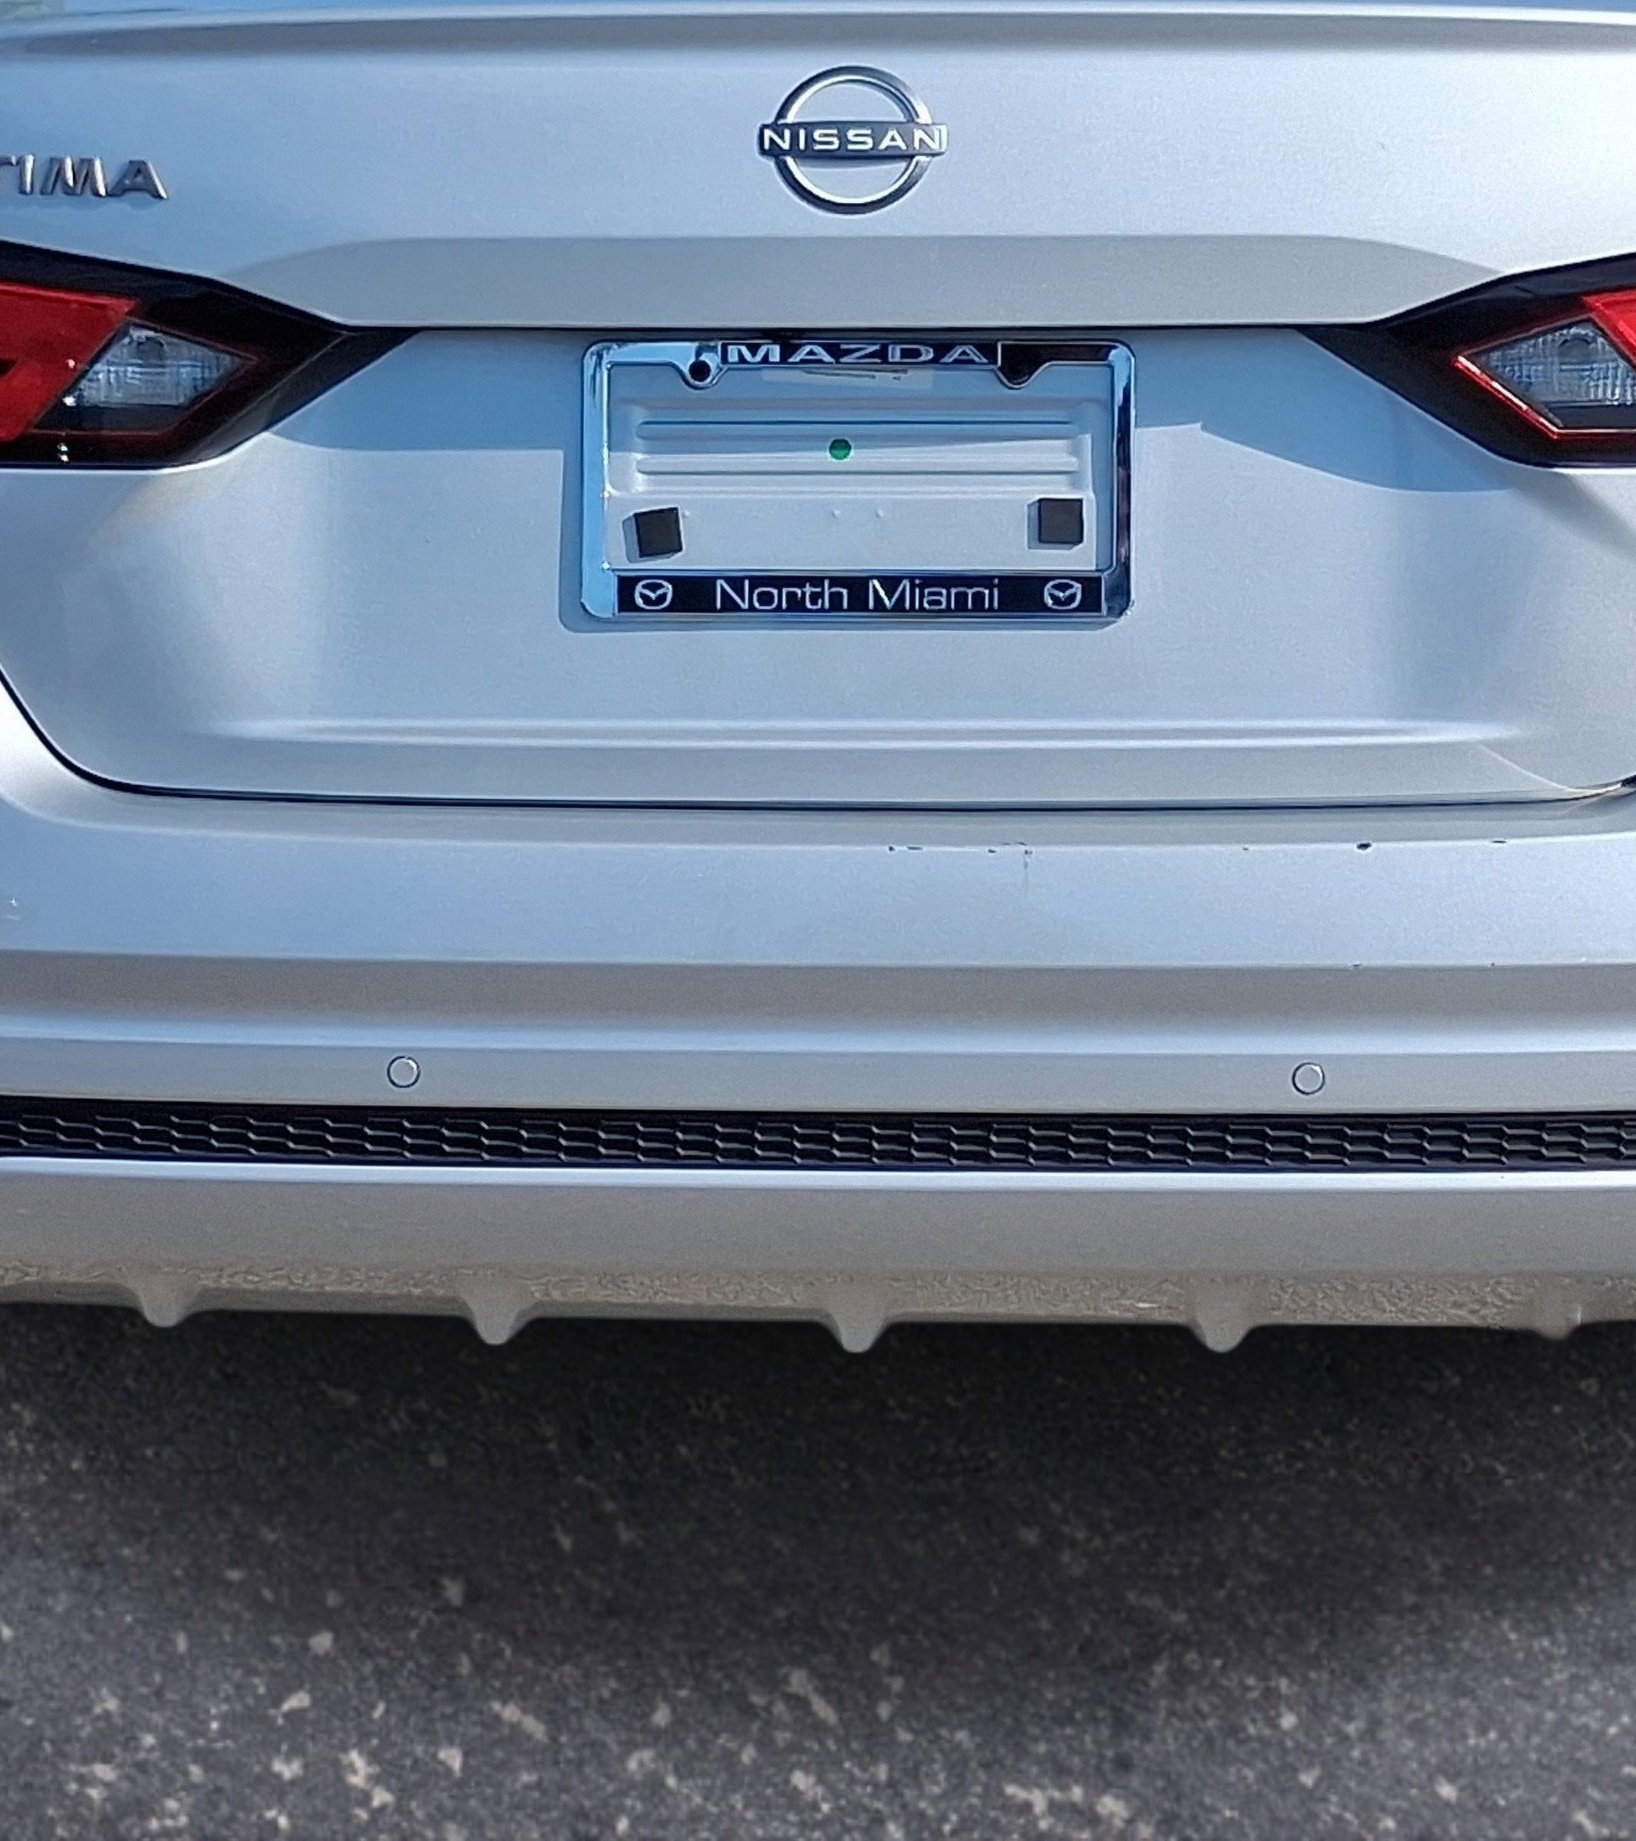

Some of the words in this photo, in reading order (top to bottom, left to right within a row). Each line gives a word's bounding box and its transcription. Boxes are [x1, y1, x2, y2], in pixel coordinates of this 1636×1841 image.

[762, 127, 941, 151] NISSAN
[726, 343, 989, 364] MAZDA
[715, 576, 849, 611] North
[867, 576, 1000, 611] Miami
